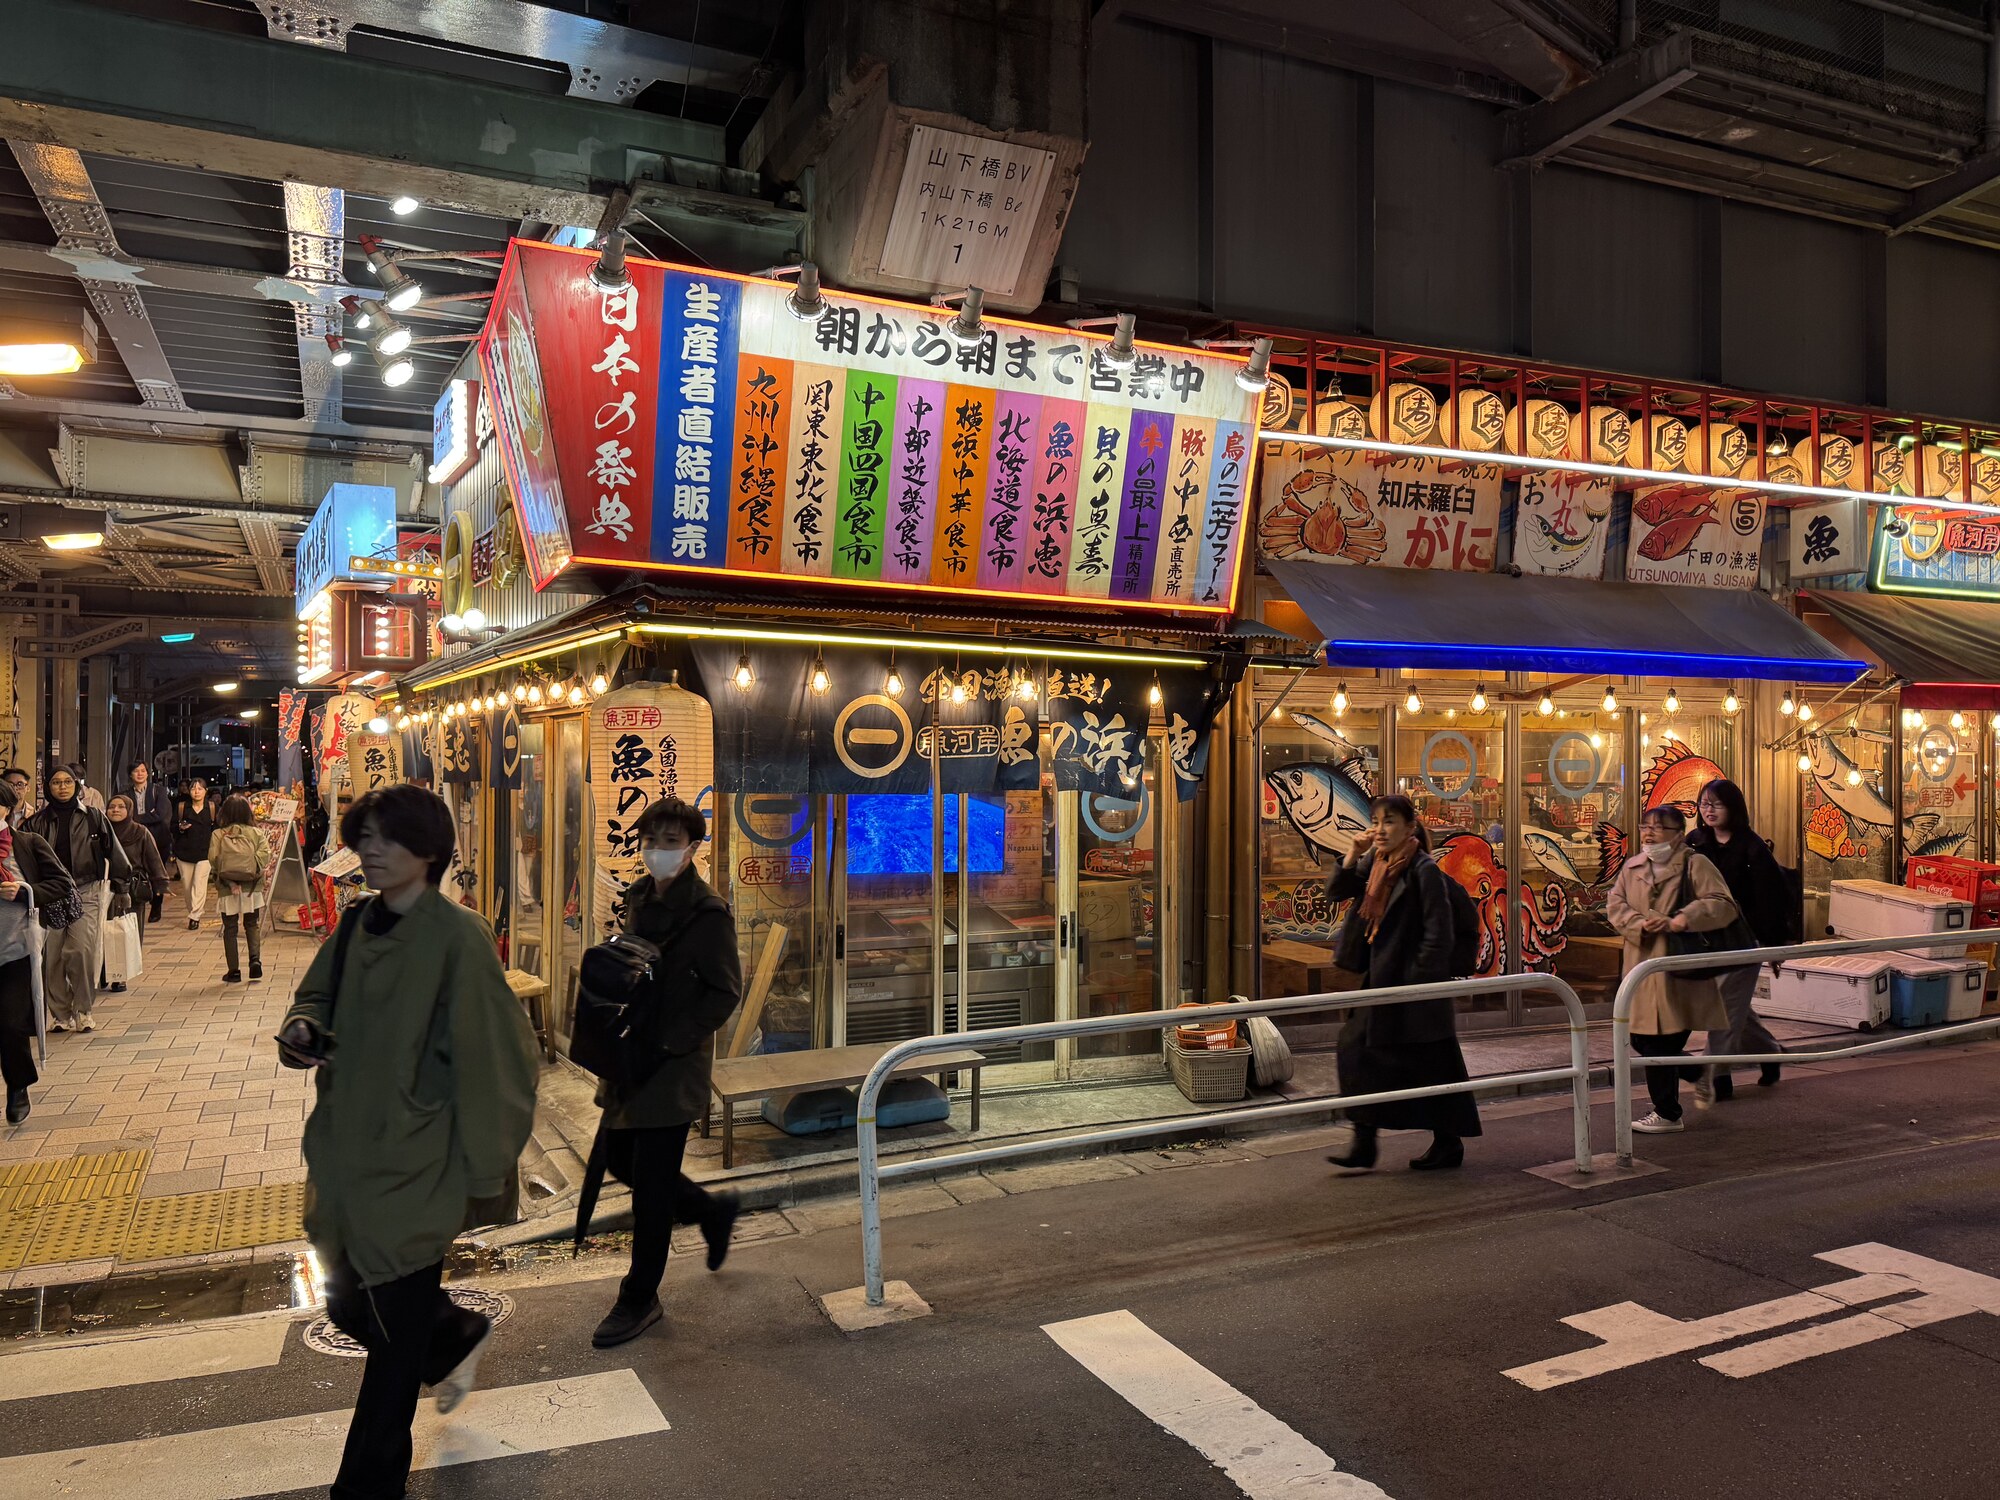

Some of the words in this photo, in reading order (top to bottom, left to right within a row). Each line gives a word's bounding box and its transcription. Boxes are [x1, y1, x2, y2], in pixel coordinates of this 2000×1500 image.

[927, 148, 1032, 183] 山下橋BV
[919, 181, 994, 209] 内山下橋
[952, 243, 964, 264] 1
[815, 306, 1205, 404] 朝から朝まで営業中
[583, 284, 641, 544] 日本の祭典
[671, 282, 722, 560] 生産者直結販売
[1405, 396, 1433, 428] 寿
[1607, 416, 1631, 446] 寿
[1664, 426, 1687, 457] 寿
[736, 366, 783, 565] 九州沖縄食市
[793, 379, 834, 568] 関東東北食市
[1827, 441, 1852, 470] 寿
[838, 381, 886, 573] 中国四国食市
[893, 395, 934, 576] 中部近畿食市
[941, 398, 984, 579] 横浜中華食市
[987, 408, 1031, 579] 北海道食市
[1027, 420, 1075, 579] 魚の浜恵
[1377, 477, 1476, 515] 知床羅臼
[1403, 514, 1493, 570] がに
[1802, 514, 1841, 566] 魚
[1949, 522, 2000, 552] 魚河岸
[1629, 567, 1707, 585] UTSUNOMIYA
[1713, 572, 1756, 588] SUISAN
[1686, 548, 1759, 572] 下田の漁港
[604, 708, 660, 728] 魚河岸
[920, 727, 999, 755] 魚河岸
[742, 859, 811, 882] 魚河岸
